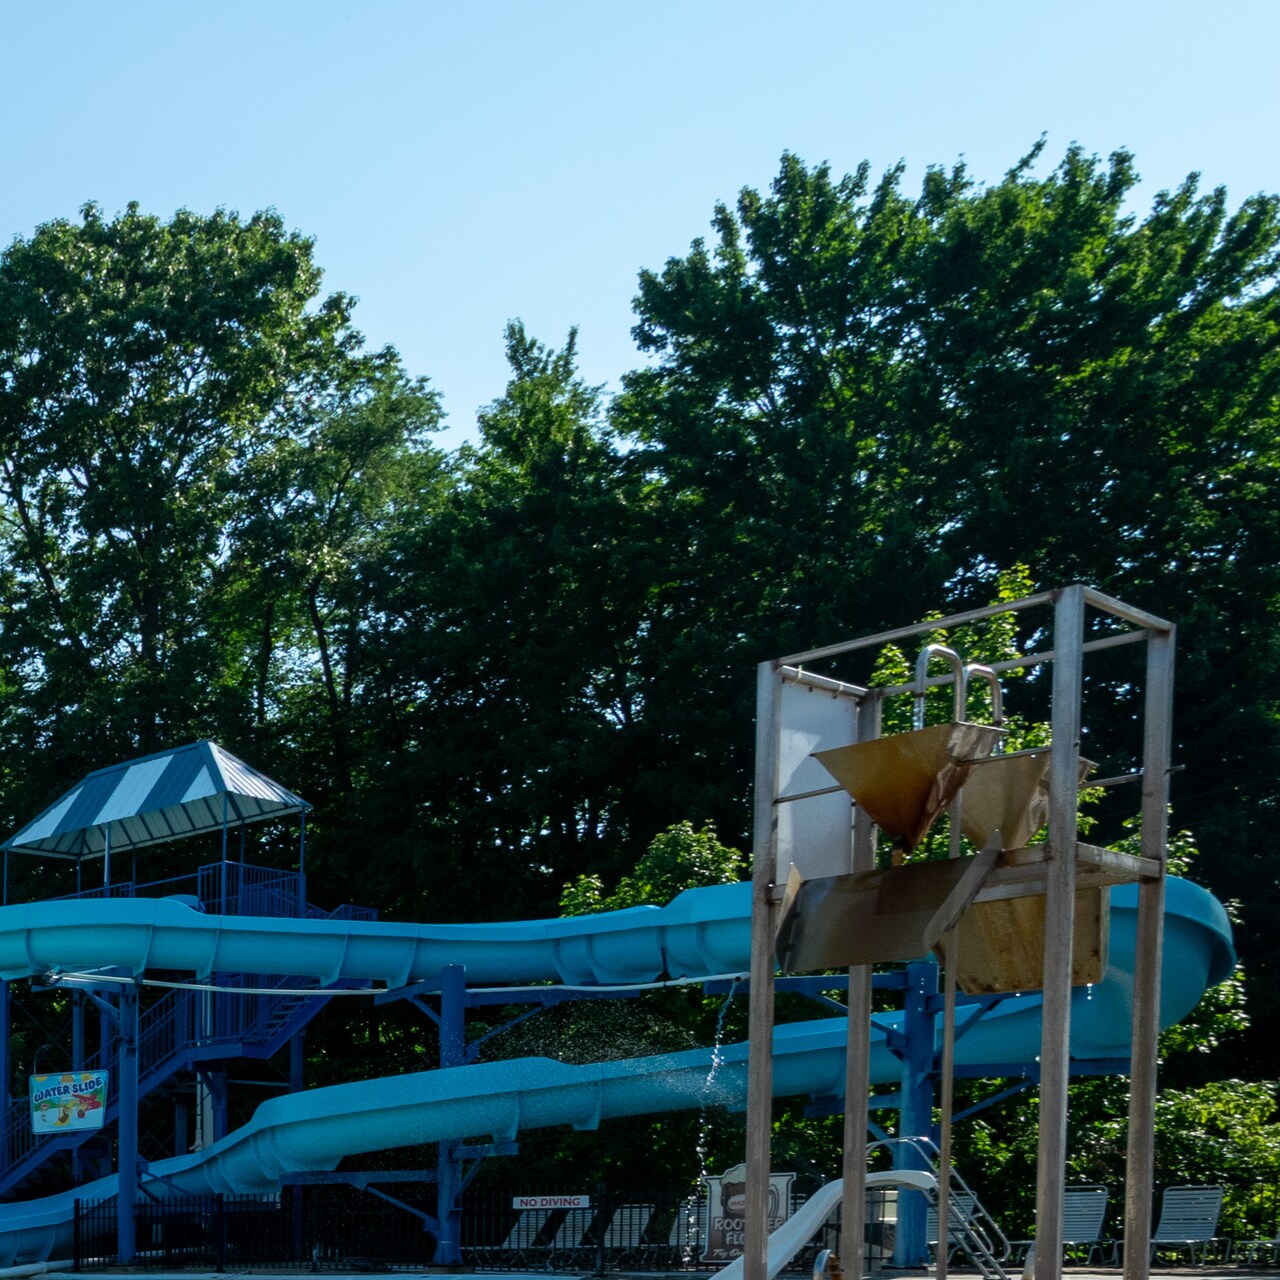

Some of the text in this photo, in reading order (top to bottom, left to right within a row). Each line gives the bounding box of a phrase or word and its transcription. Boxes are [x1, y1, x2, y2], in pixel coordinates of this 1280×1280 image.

[33, 1076, 103, 1102] WATER SLIDE
[520, 1197, 581, 1207] NO DIVING
[714, 1218, 745, 1231] ROO
